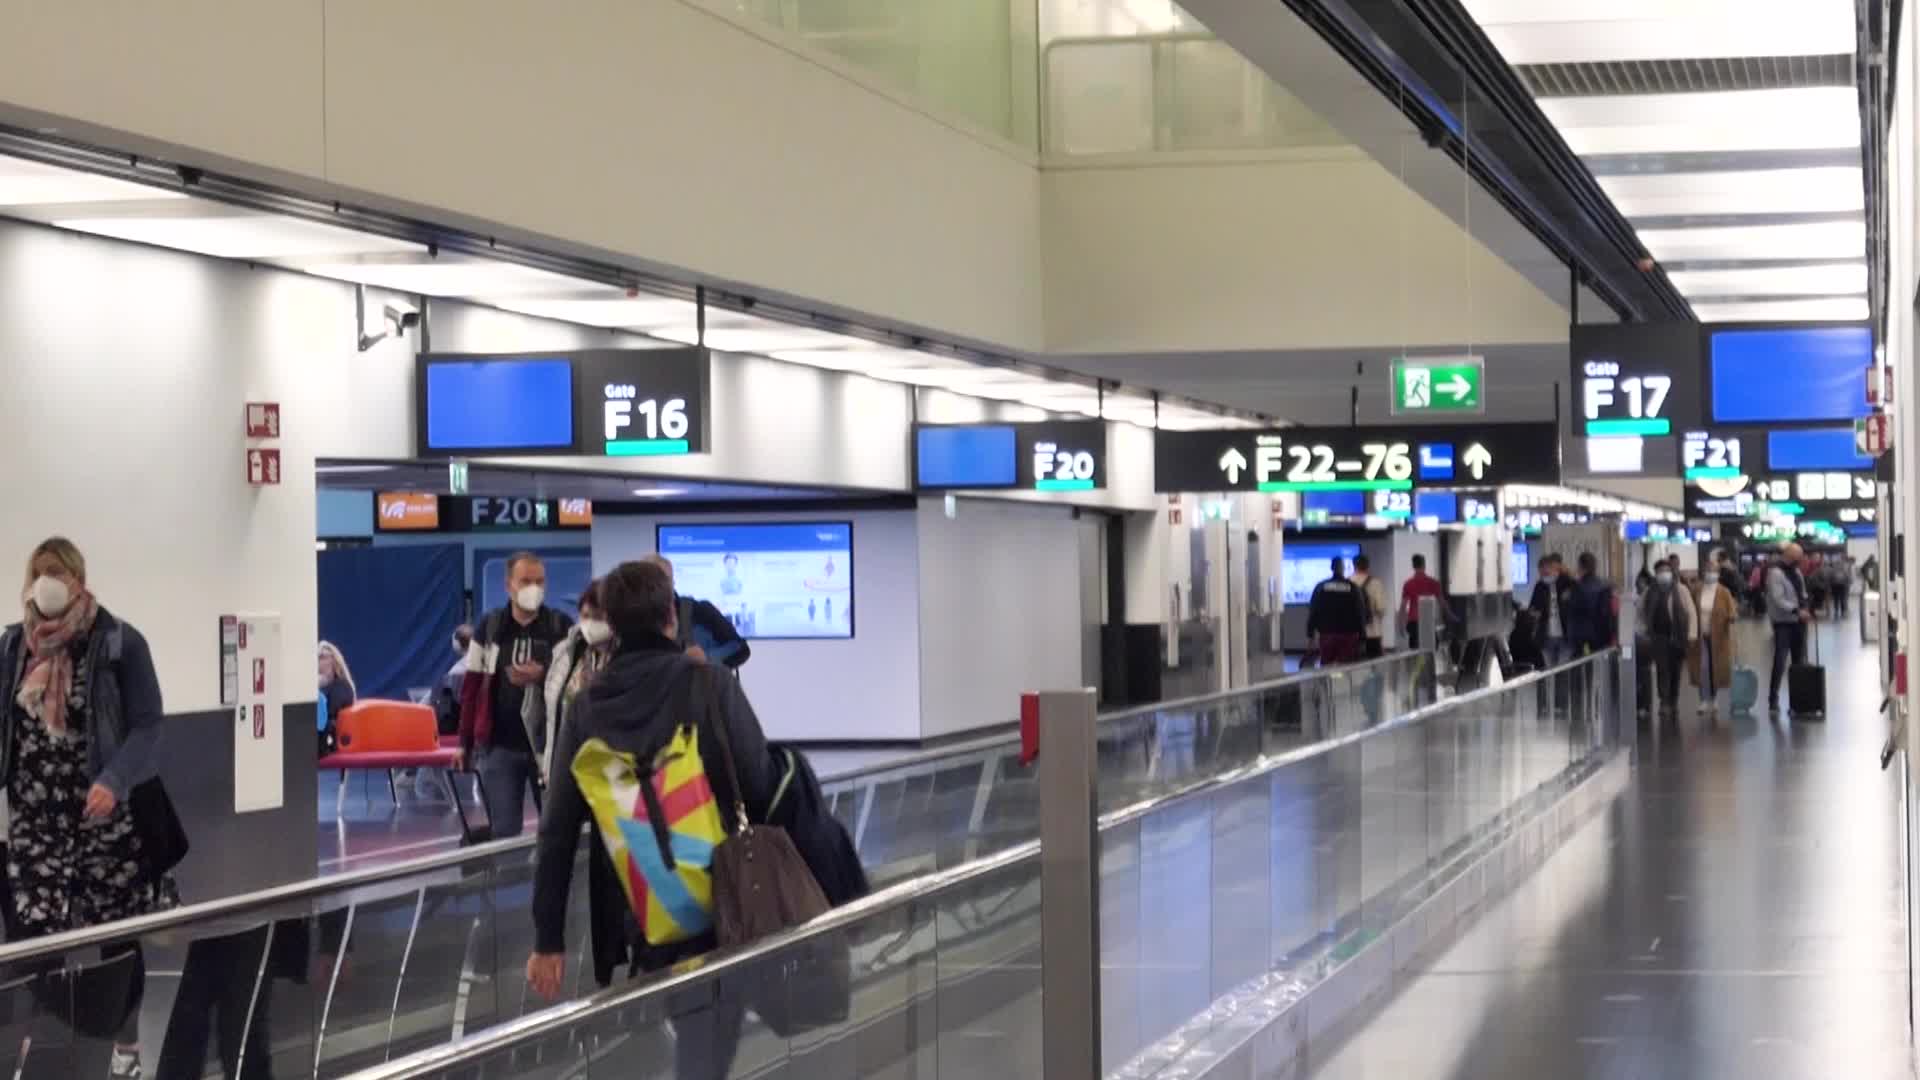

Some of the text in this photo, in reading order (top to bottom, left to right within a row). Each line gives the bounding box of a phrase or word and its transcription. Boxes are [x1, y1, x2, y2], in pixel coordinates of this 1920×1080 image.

[1584, 361, 1619, 376] Gate
[604, 384, 636, 398] Gate
[1584, 376, 1671, 420] F 17
[604, 399, 688, 439] F 16
[1034, 452, 1094, 481] F 20
[1256, 447, 1282, 482] F
[1684, 439, 1740, 468] F 21
[472, 499, 489, 524] F
[495, 497, 531, 524] 20
